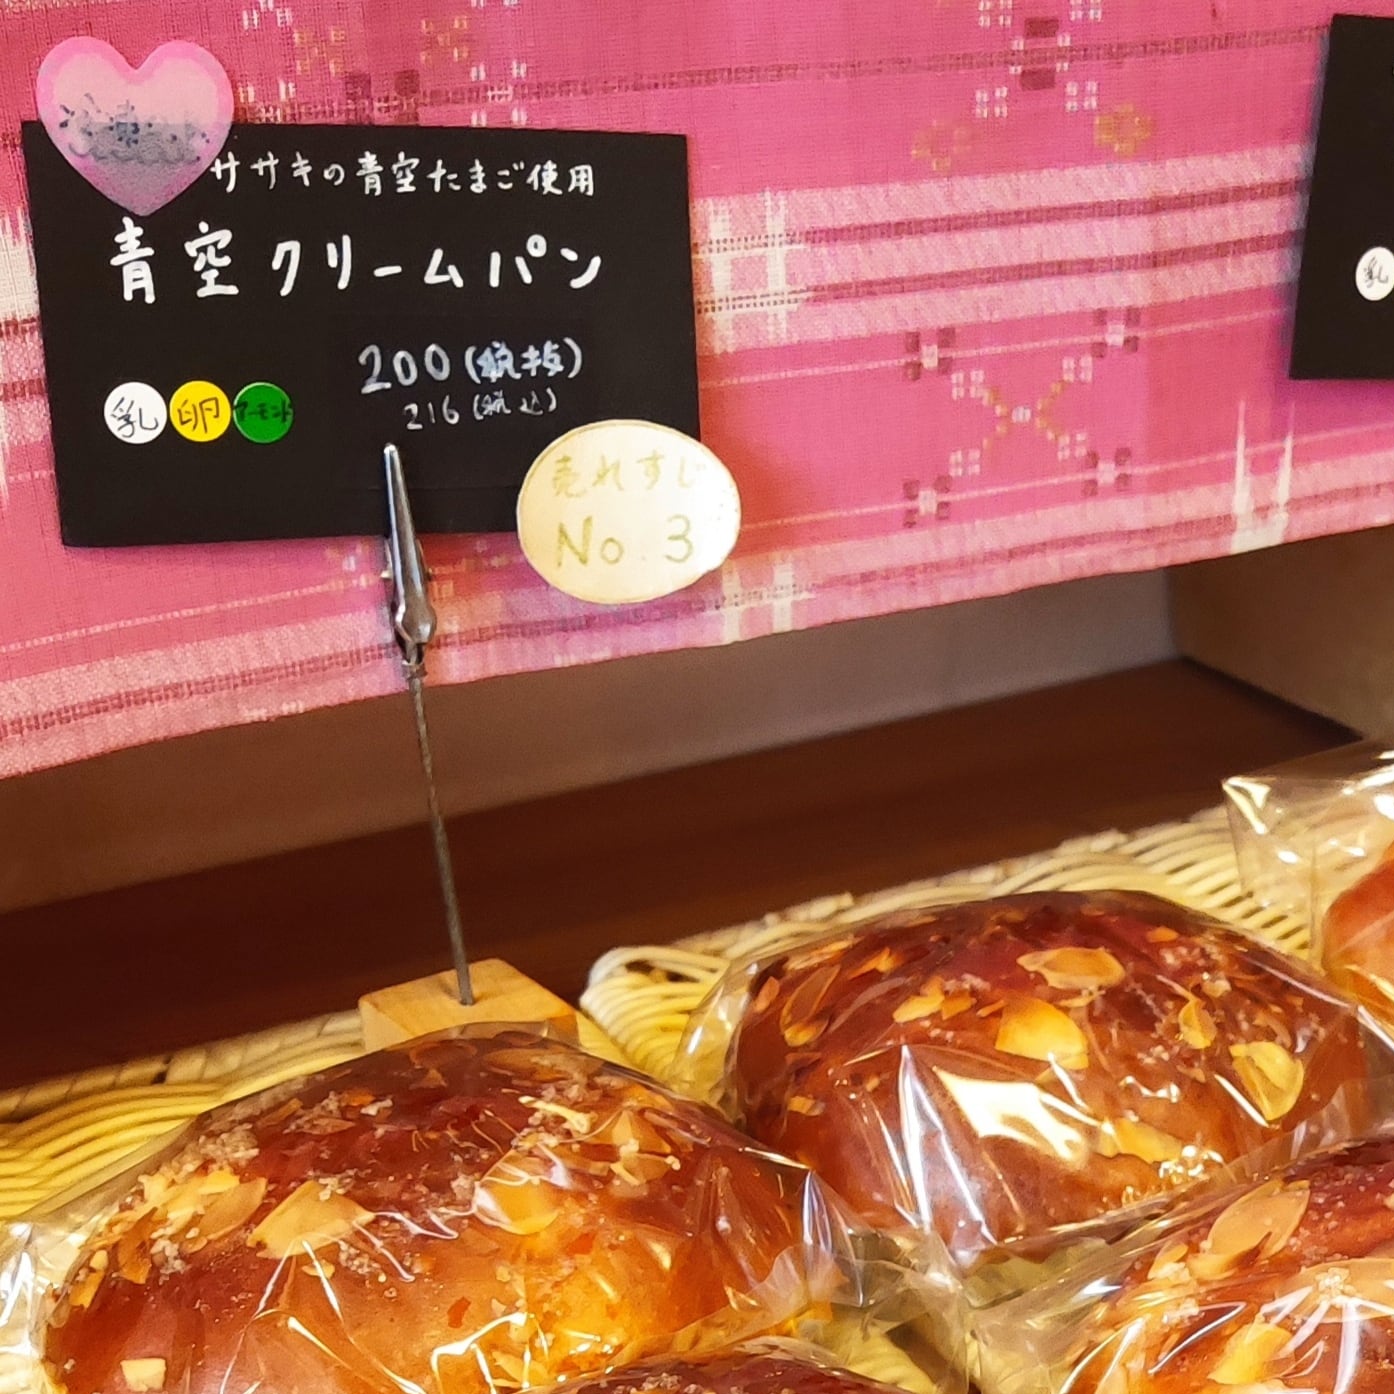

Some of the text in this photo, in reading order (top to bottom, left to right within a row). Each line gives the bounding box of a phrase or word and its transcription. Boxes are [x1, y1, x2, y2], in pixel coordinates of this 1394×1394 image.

[210, 150, 596, 197] ササキの青空たまご使用
[109, 216, 603, 304] 青空クリームパン
[112, 396, 160, 439] 乳
[176, 397, 222, 434] 卵
[664, 513, 694, 564] 3
